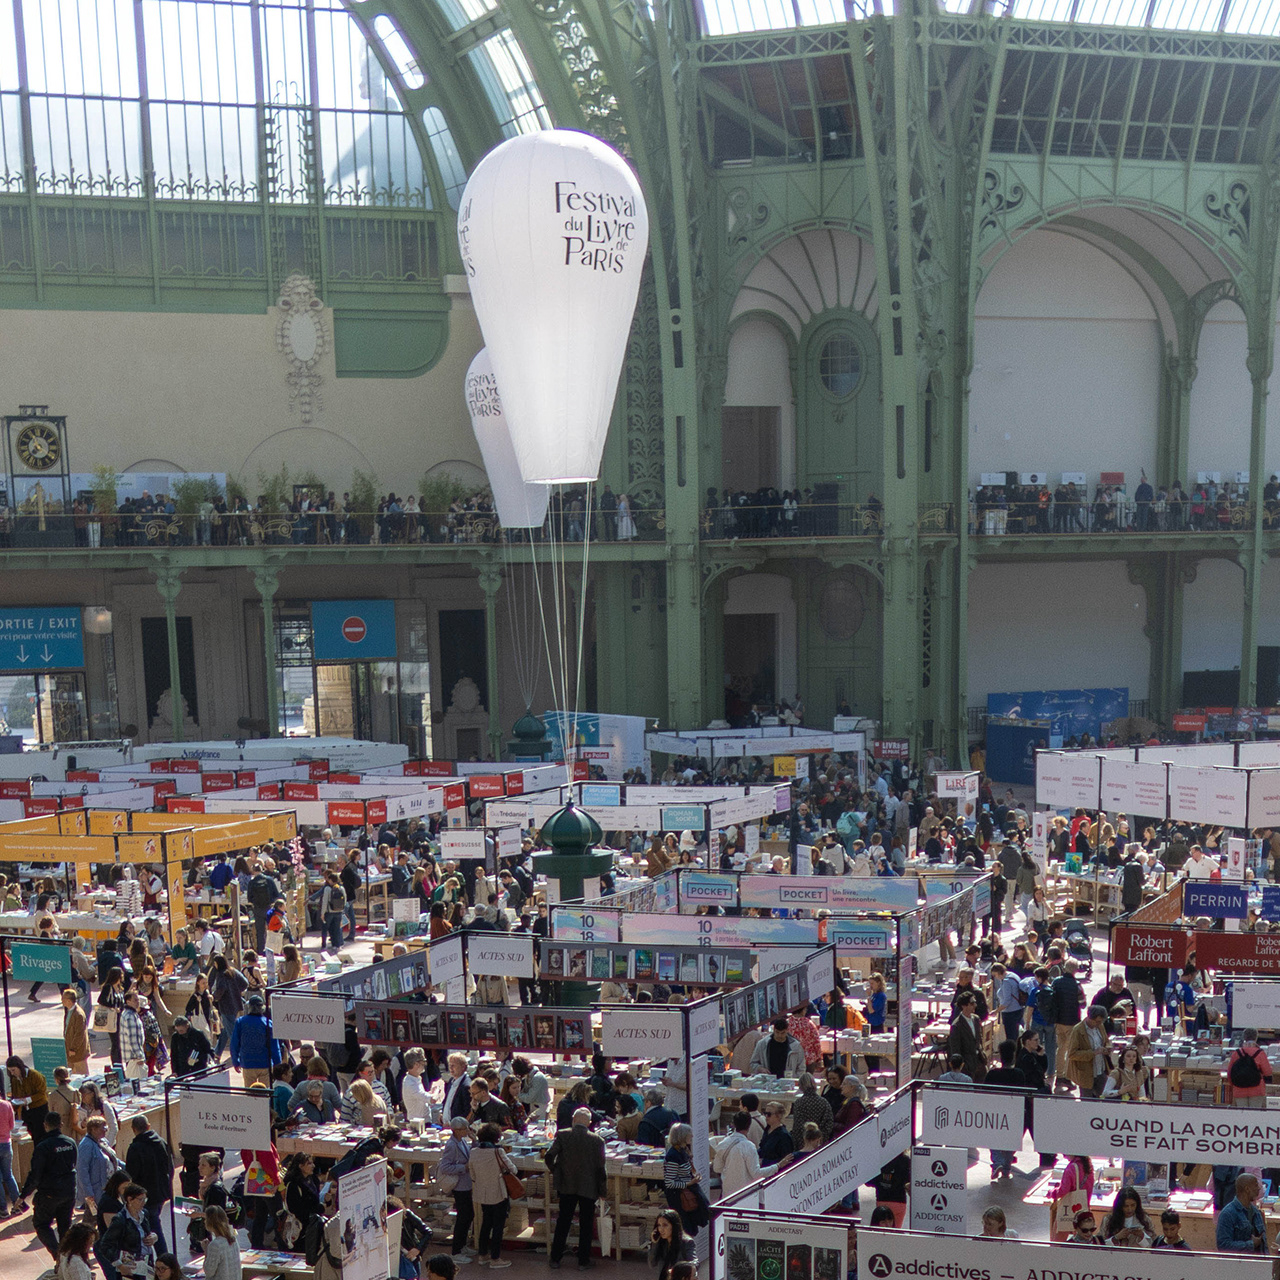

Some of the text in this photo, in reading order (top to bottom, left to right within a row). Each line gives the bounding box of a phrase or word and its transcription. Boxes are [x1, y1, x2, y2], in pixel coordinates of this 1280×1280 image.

[554, 181, 636, 217] Festival
[564, 214, 635, 244] du Livre
[616, 238, 629, 252] de
[39, 618, 44, 631] /
[49, 617, 78, 629] EXIT
[12, 634, 33, 643] pour
[56, 632, 78, 640] visite
[691, 887, 729, 896] POCKET
[948, 881, 964, 894] 10
[783, 890, 823, 899] POCKET
[1190, 894, 1242, 908] PERRIN
[580, 914, 595, 928] 10
[697, 920, 712, 934] 10
[580, 931, 595, 942] 18
[697, 936, 712, 948] 18
[837, 936, 882, 946] POCKET
[1130, 933, 1173, 950] Robert
[478, 951, 524, 962] ACTES SUD
[1127, 947, 1173, 963] Laffont
[20, 954, 63, 973] Rivages
[1218, 957, 1260, 967] REGARDE
[1262, 959, 1274, 968] DE
[282, 1013, 335, 1025] ACTES SUD
[613, 1028, 671, 1039] ACTES SUD
[198, 1111, 253, 1124] LES MOTS
[954, 1110, 1009, 1132] ADONIA
[204, 1122, 247, 1133] École d'écriture
[887, 1115, 910, 1140] addictives
[1090, 1116, 1164, 1134] QUAND
[1170, 1120, 1195, 1136] LA
[1110, 1134, 1137, 1148] SE
[1144, 1136, 1189, 1151] FAIT
[789, 1173, 814, 1201] QUAND
[822, 1146, 854, 1181] ROMANCE
[832, 1164, 859, 1194] FANTASY
[914, 1179, 965, 1190] addictives
[914, 1212, 964, 1223] ADDICTASY
[729, 1223, 804, 1236] PAD12 ADDICTASY
